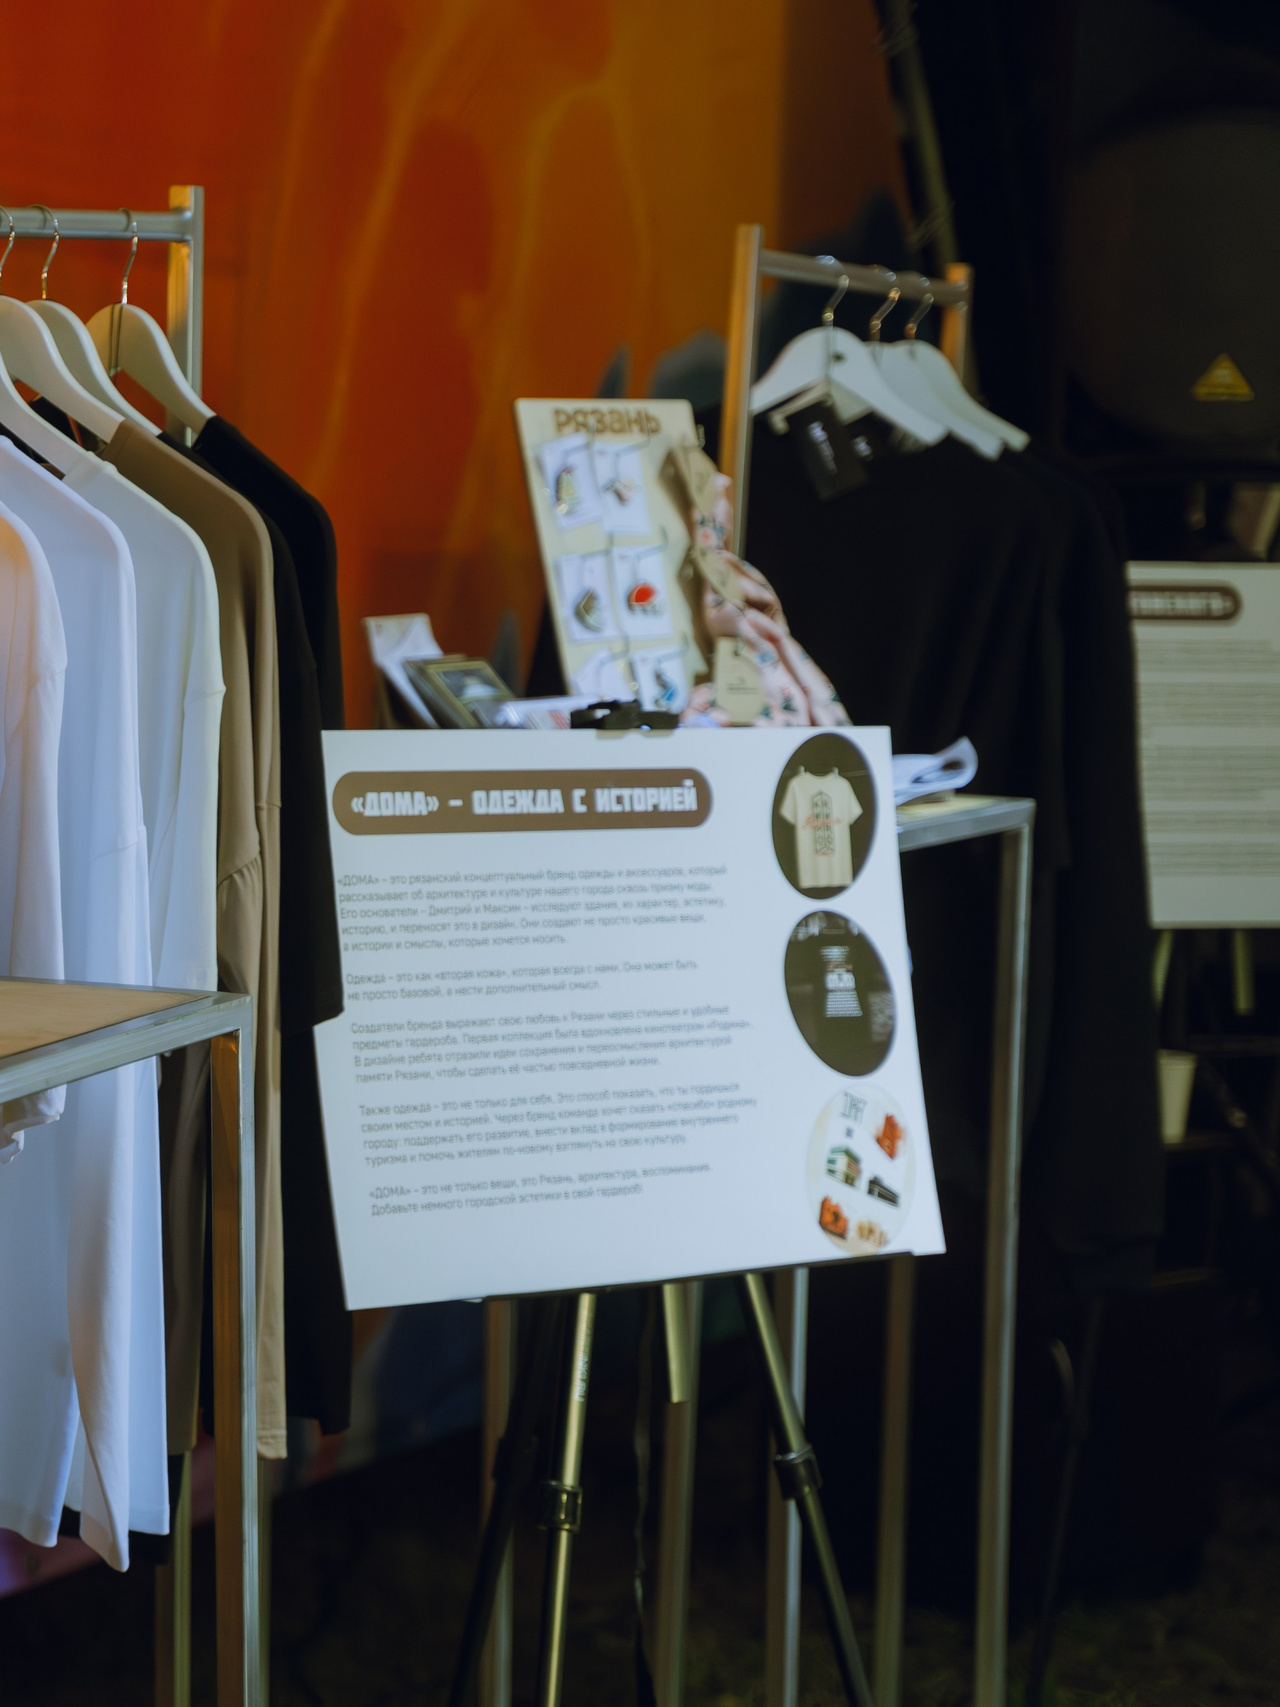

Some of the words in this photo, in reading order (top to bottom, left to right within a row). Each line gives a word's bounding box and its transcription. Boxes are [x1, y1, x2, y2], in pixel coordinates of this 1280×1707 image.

[350, 791, 440, 816] «ДОМА»
[472, 788, 565, 815] ОДЕЖДА
[572, 788, 588, 812] С
[595, 778, 698, 812] ИСТОРИЕЙ
